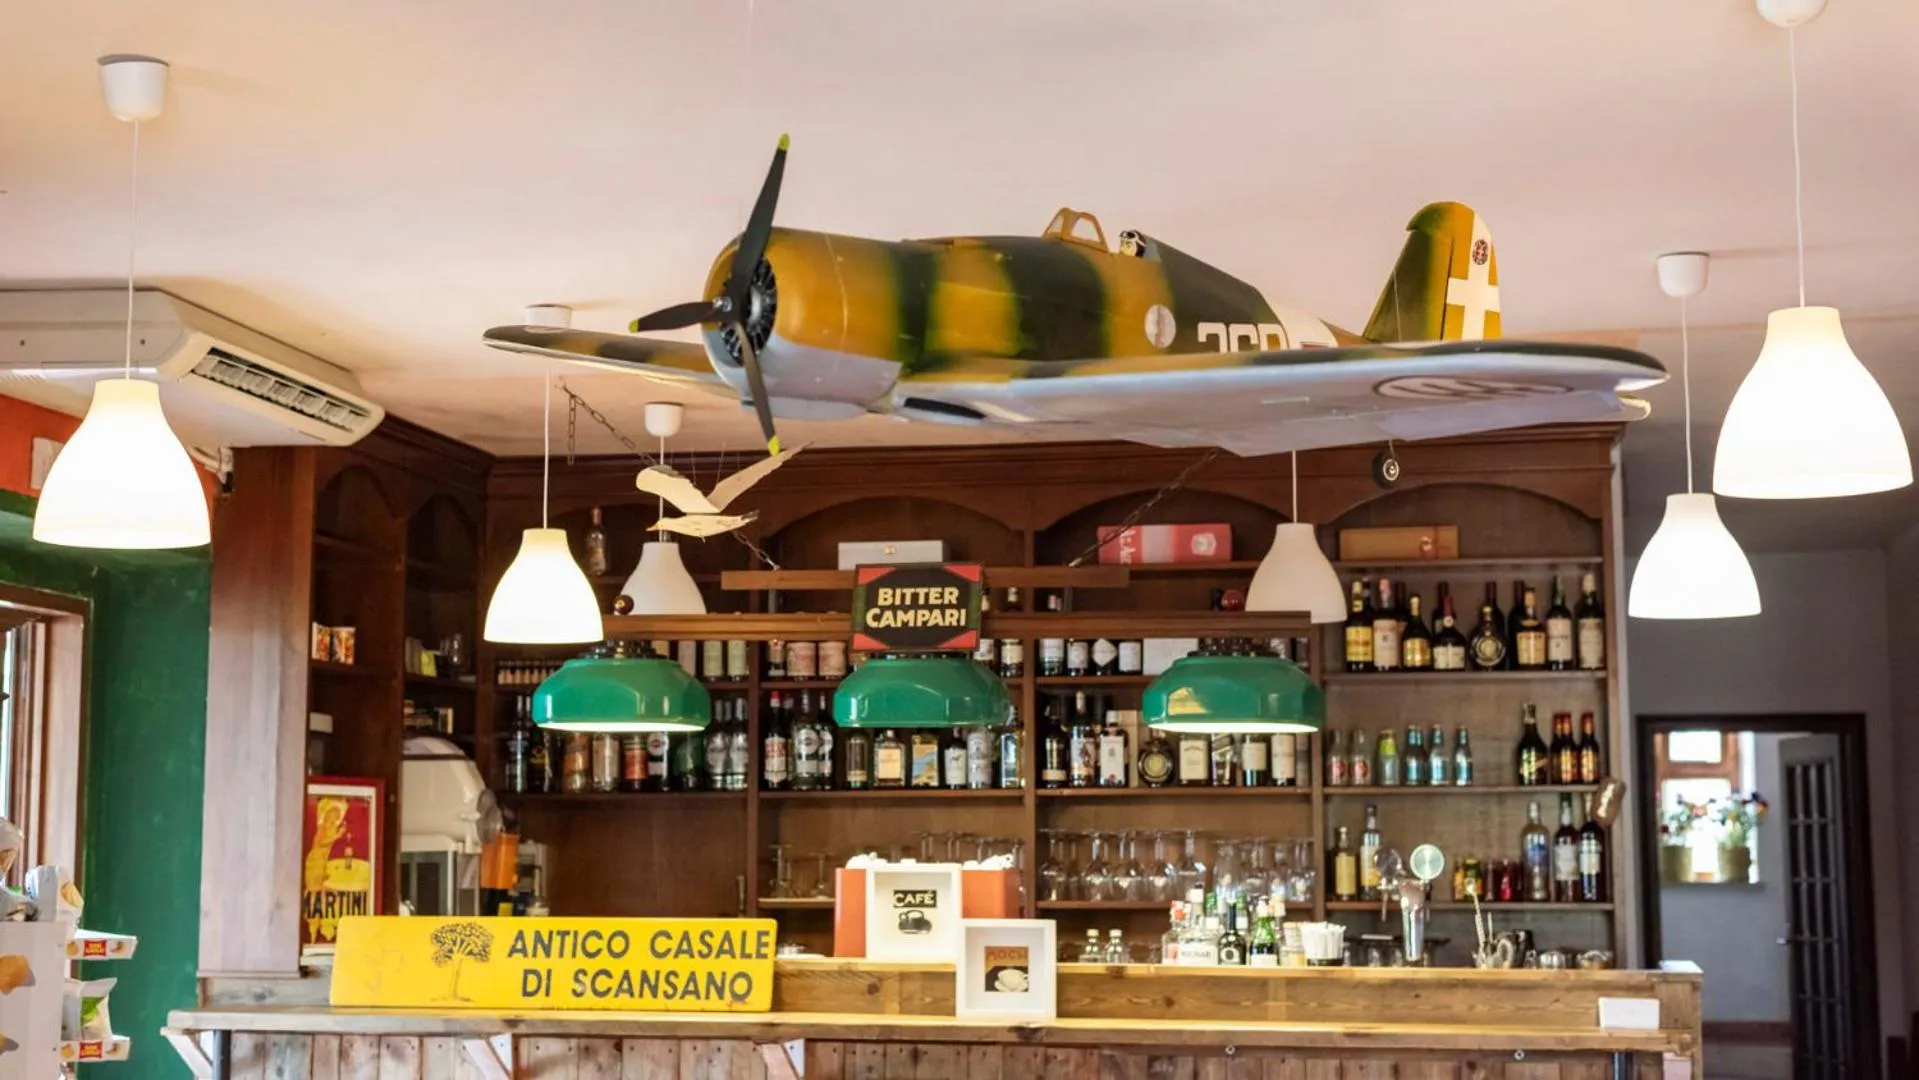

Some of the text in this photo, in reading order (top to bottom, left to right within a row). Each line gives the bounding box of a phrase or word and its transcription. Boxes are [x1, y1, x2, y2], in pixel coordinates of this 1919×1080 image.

[877, 587, 959, 606] BITTER
[865, 608, 967, 628] CAMPARI
[894, 889, 935, 907] CAFÉ
[507, 929, 770, 960] ANTICO CASALE
[521, 968, 754, 1001] DI SCANSANO
